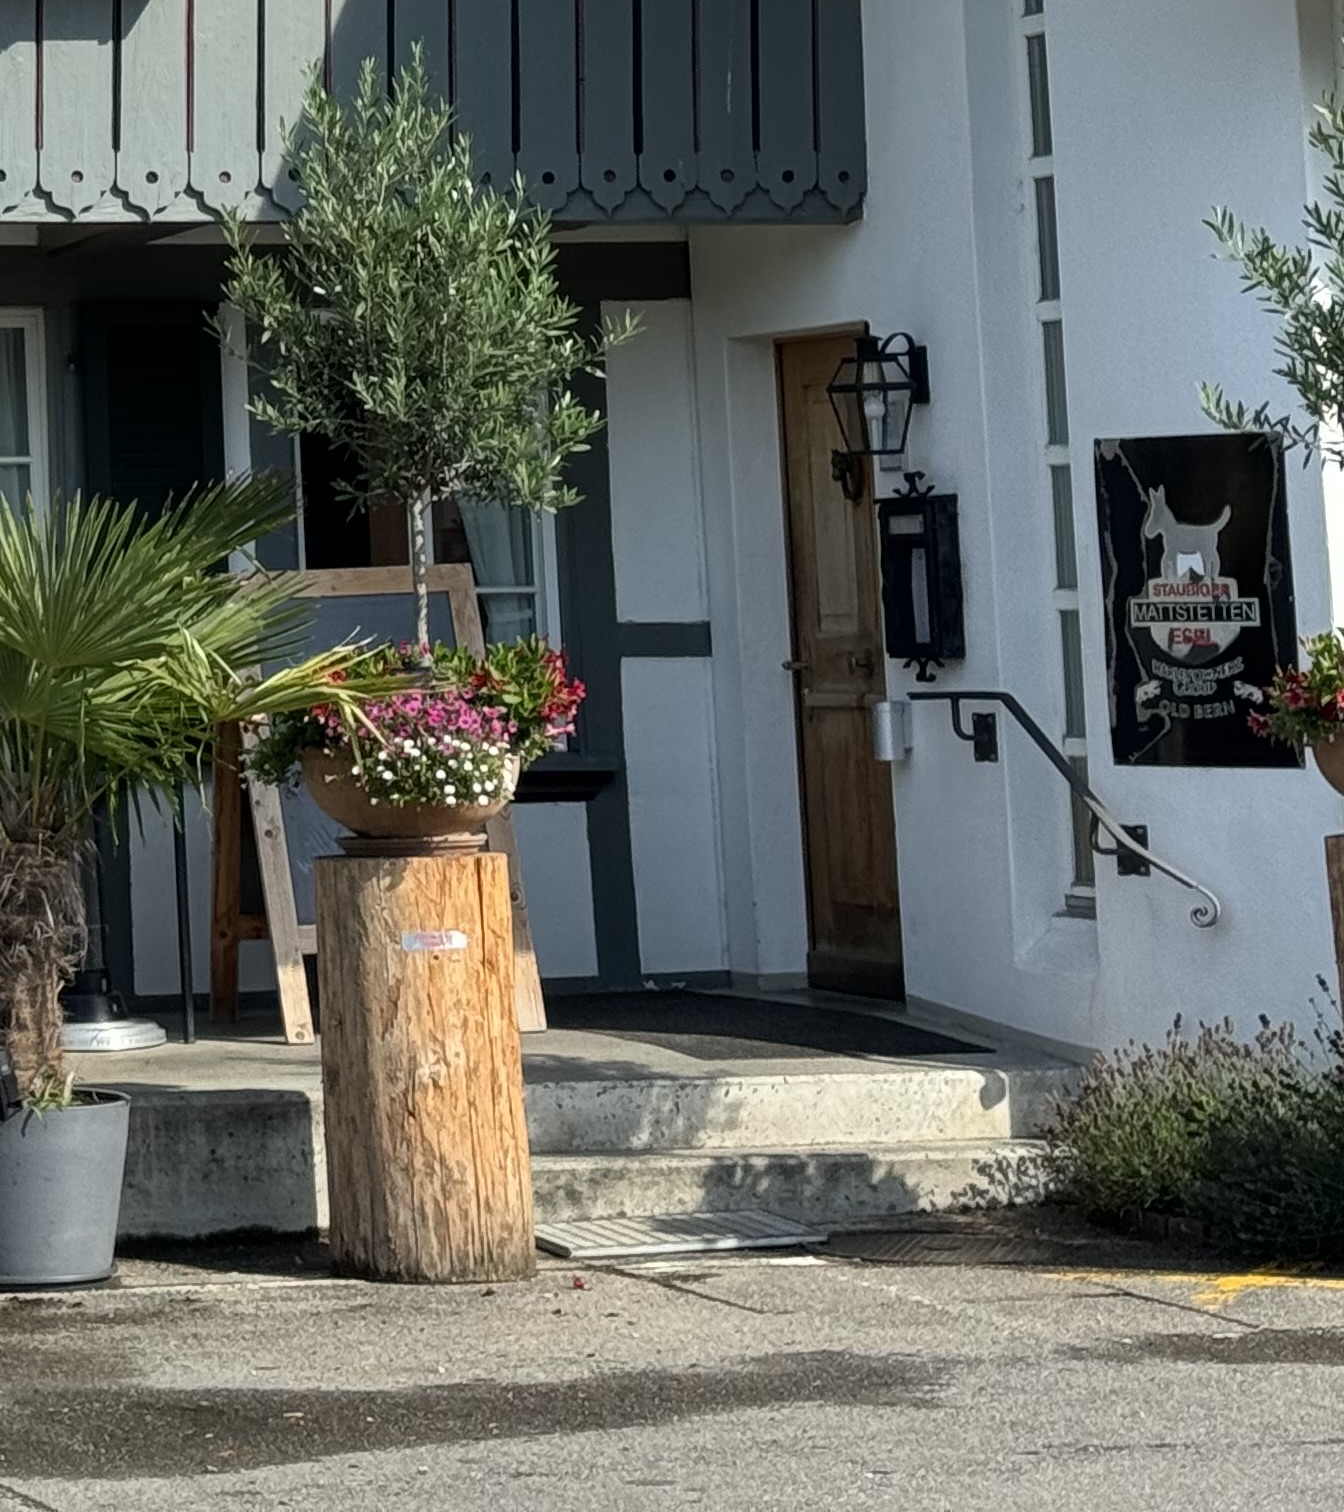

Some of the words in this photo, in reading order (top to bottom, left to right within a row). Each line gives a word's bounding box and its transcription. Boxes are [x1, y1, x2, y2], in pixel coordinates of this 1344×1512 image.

[1133, 602, 1255, 621] MATTSTETTEN
[1159, 699, 1191, 718] OLD
[1193, 699, 1236, 719] BERN
